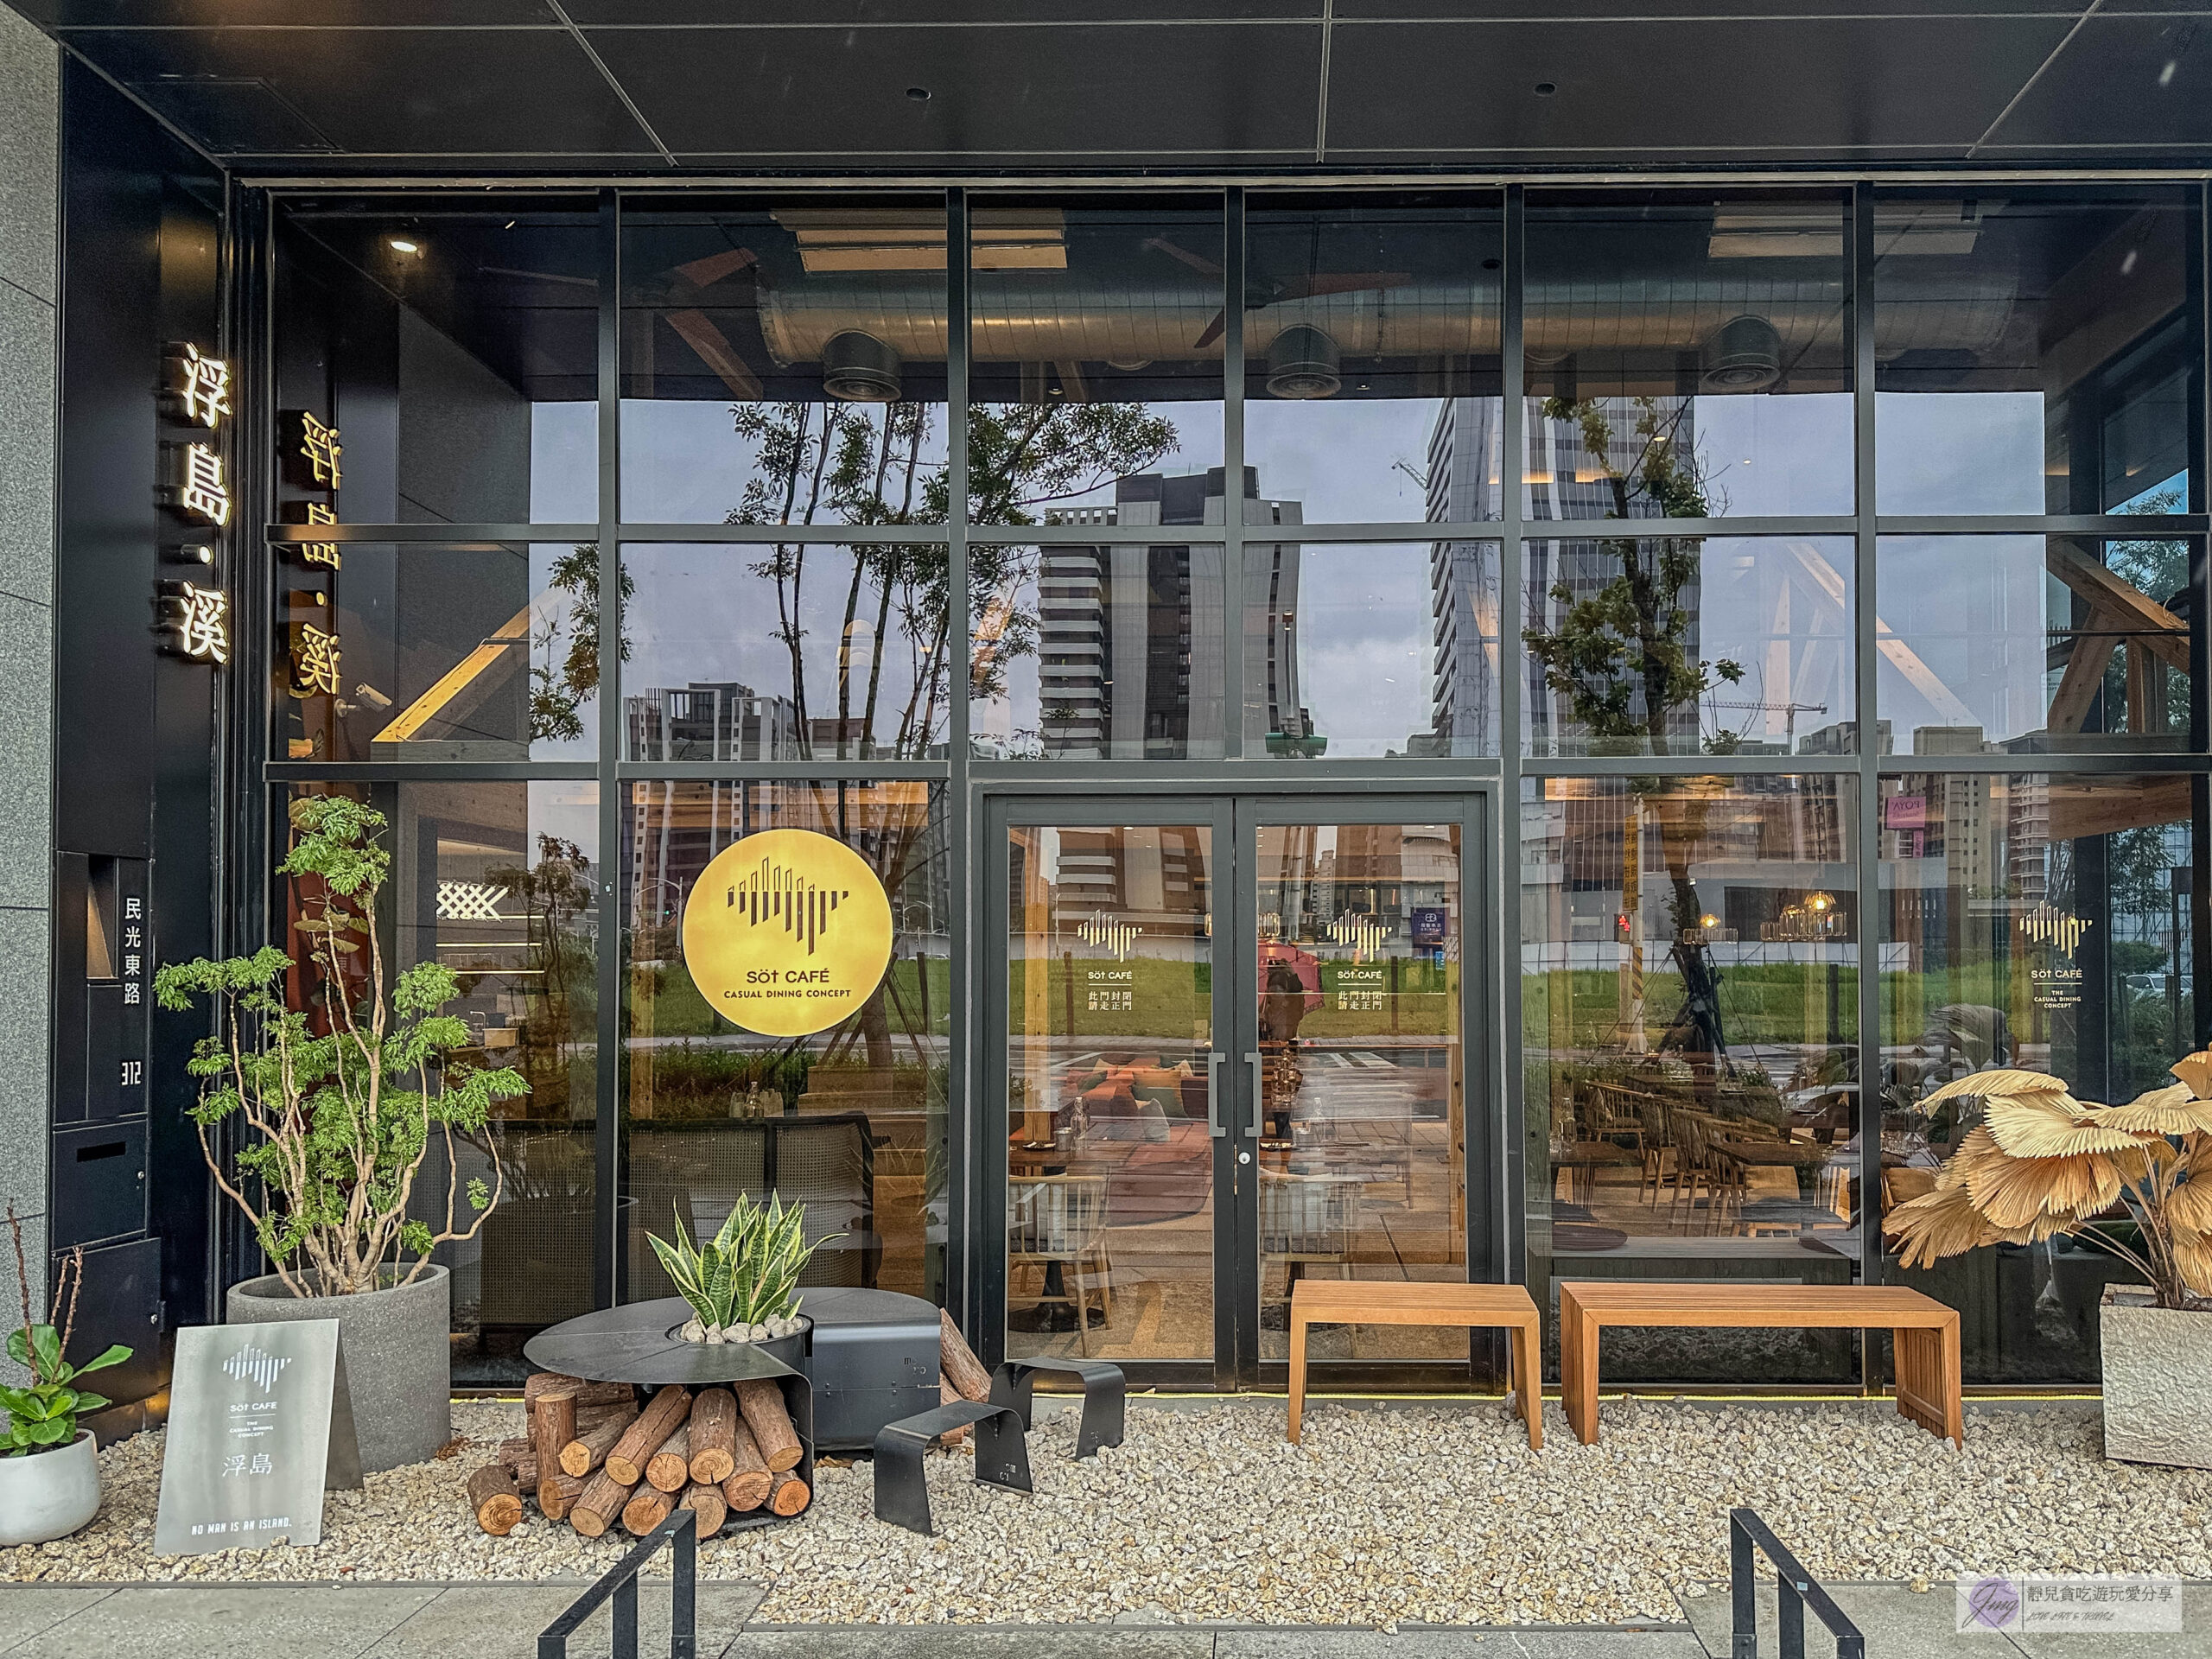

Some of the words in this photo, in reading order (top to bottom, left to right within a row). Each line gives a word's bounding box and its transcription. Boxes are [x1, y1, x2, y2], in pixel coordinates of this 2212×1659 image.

[124, 898, 142, 1004] 民光東路
[785, 968, 830, 983] CAFÉ
[1108, 970, 1132, 980] CAFÉ
[1357, 970, 1382, 979] CAFÉ
[2055, 968, 2082, 978] CAFÉ
[766, 989, 802, 998] DINING
[1089, 991, 1132, 1001] 此門封閉
[1338, 991, 1382, 1001] 此門封閉
[122, 1061, 142, 1086] 312
[222, 1453, 272, 1477] 浮島
[191, 1525, 203, 1535] NO
[207, 1522, 226, 1534] MAN
[230, 1522, 239, 1532] IS
[243, 1521, 255, 1531] AN
[259, 1517, 292, 1529] ISLAND.
